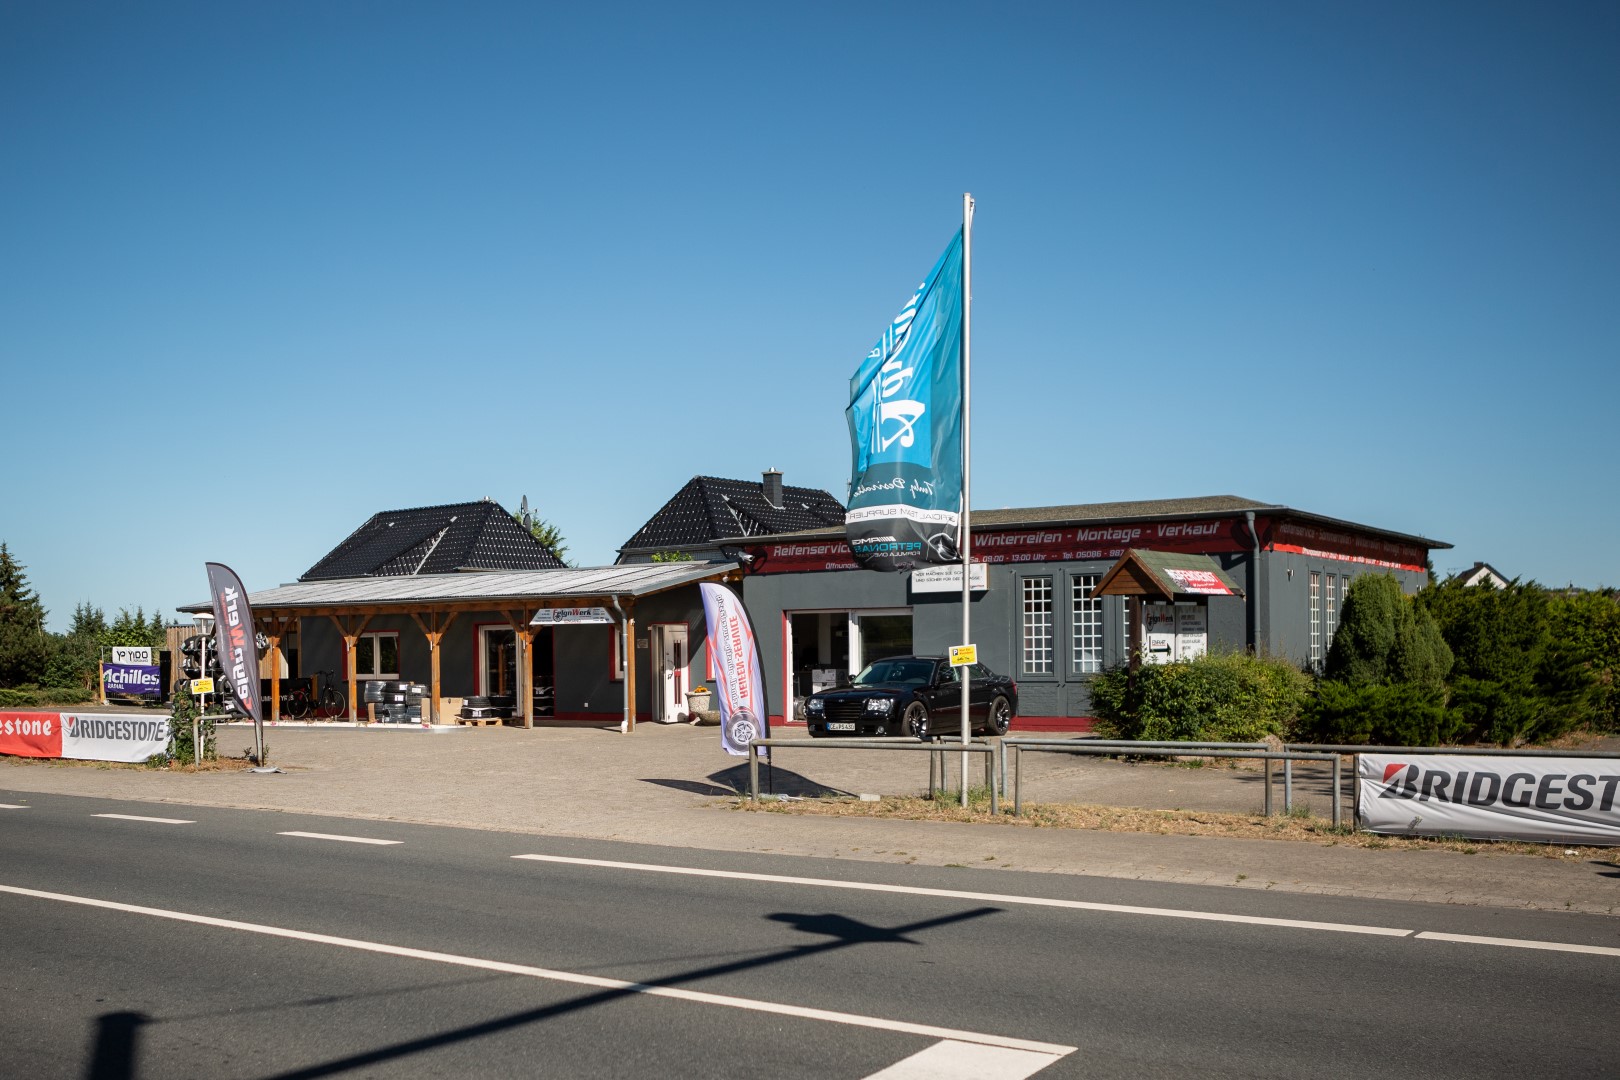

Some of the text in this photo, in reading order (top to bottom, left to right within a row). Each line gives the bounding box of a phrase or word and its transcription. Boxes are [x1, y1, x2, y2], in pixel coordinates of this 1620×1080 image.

[974, 531, 1062, 546] Winterreifen
[1076, 528, 1141, 542] Montage
[1157, 522, 1221, 537] Verkauf
[1076, 550, 1102, 558] 05086
[128, 651, 148, 662] YIDO
[104, 669, 160, 685] Achilles
[70, 716, 165, 742] BRIDGESTONE
